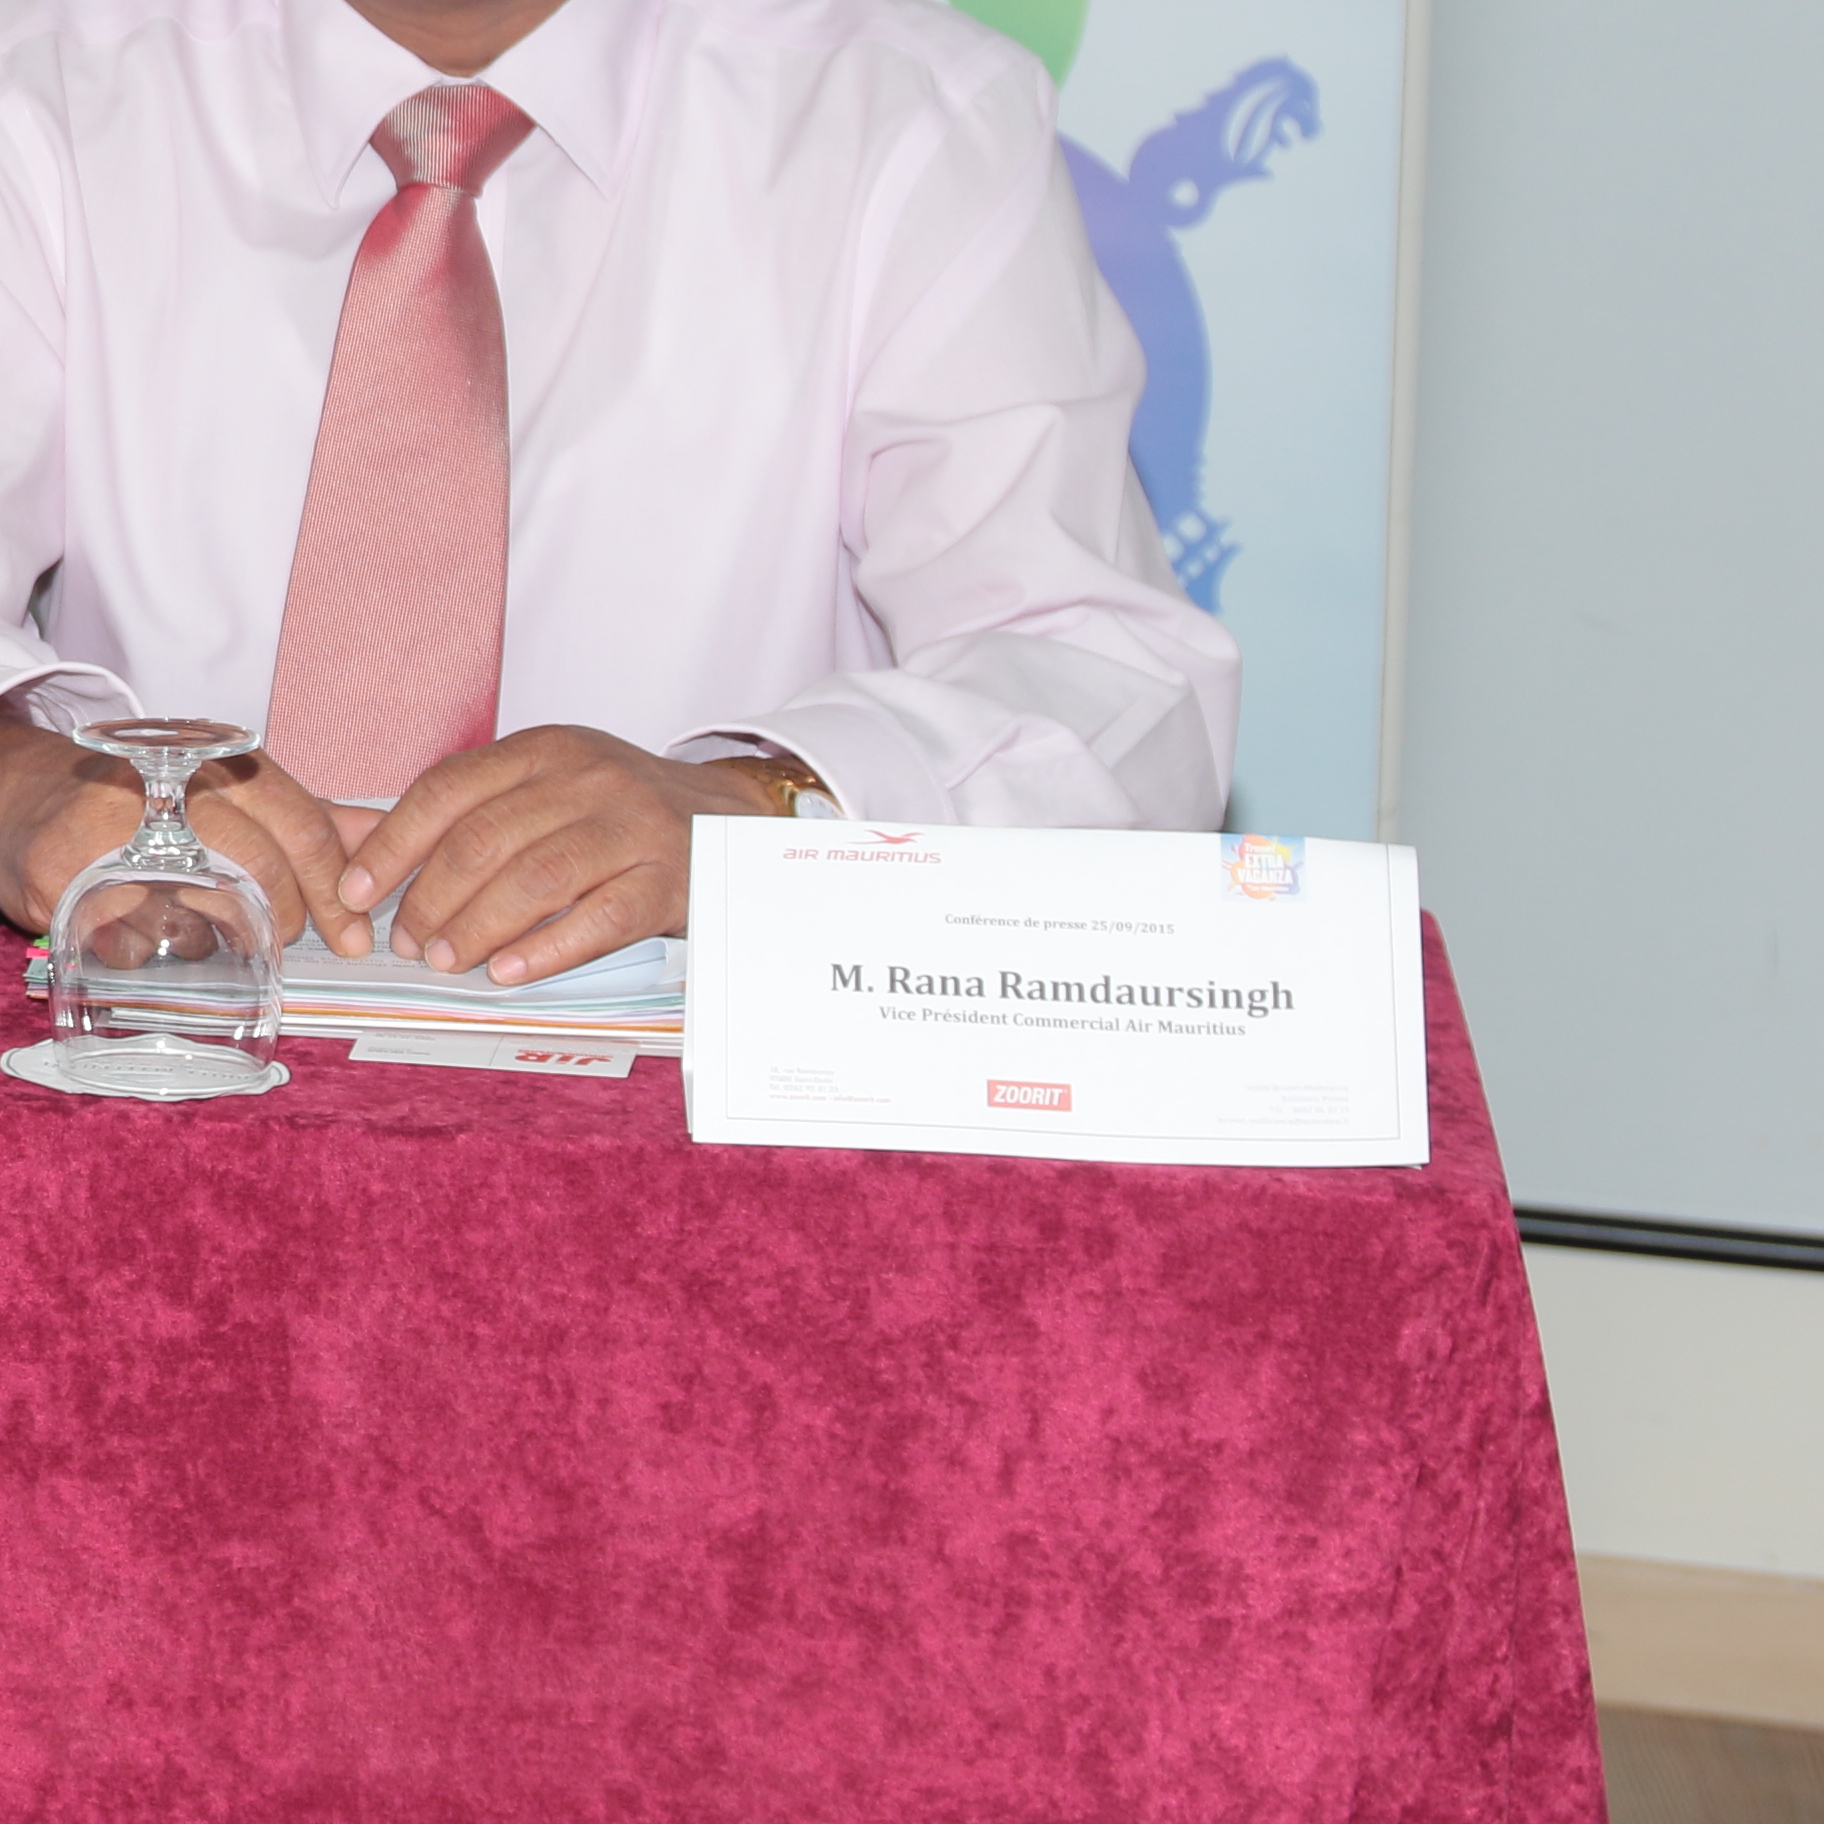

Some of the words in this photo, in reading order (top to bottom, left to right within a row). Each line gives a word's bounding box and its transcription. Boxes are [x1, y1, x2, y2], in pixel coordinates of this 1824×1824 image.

[944, 913, 1021, 928] Conférence
[1023, 916, 1041, 928] de
[1043, 920, 1088, 934] presse
[1091, 919, 1175, 935] 25/09/2015
[831, 963, 874, 993] M.
[887, 965, 986, 998] Rana
[999, 970, 1295, 1019] Ramdaursingh
[878, 1006, 917, 1021] Vice
[921, 1007, 1008, 1026] Président
[1012, 1012, 1121, 1032] Commercial
[1125, 1018, 1153, 1033] Air
[1157, 1019, 1246, 1036] Mauritius
[993, 1084, 1064, 1106] ZOORIT
